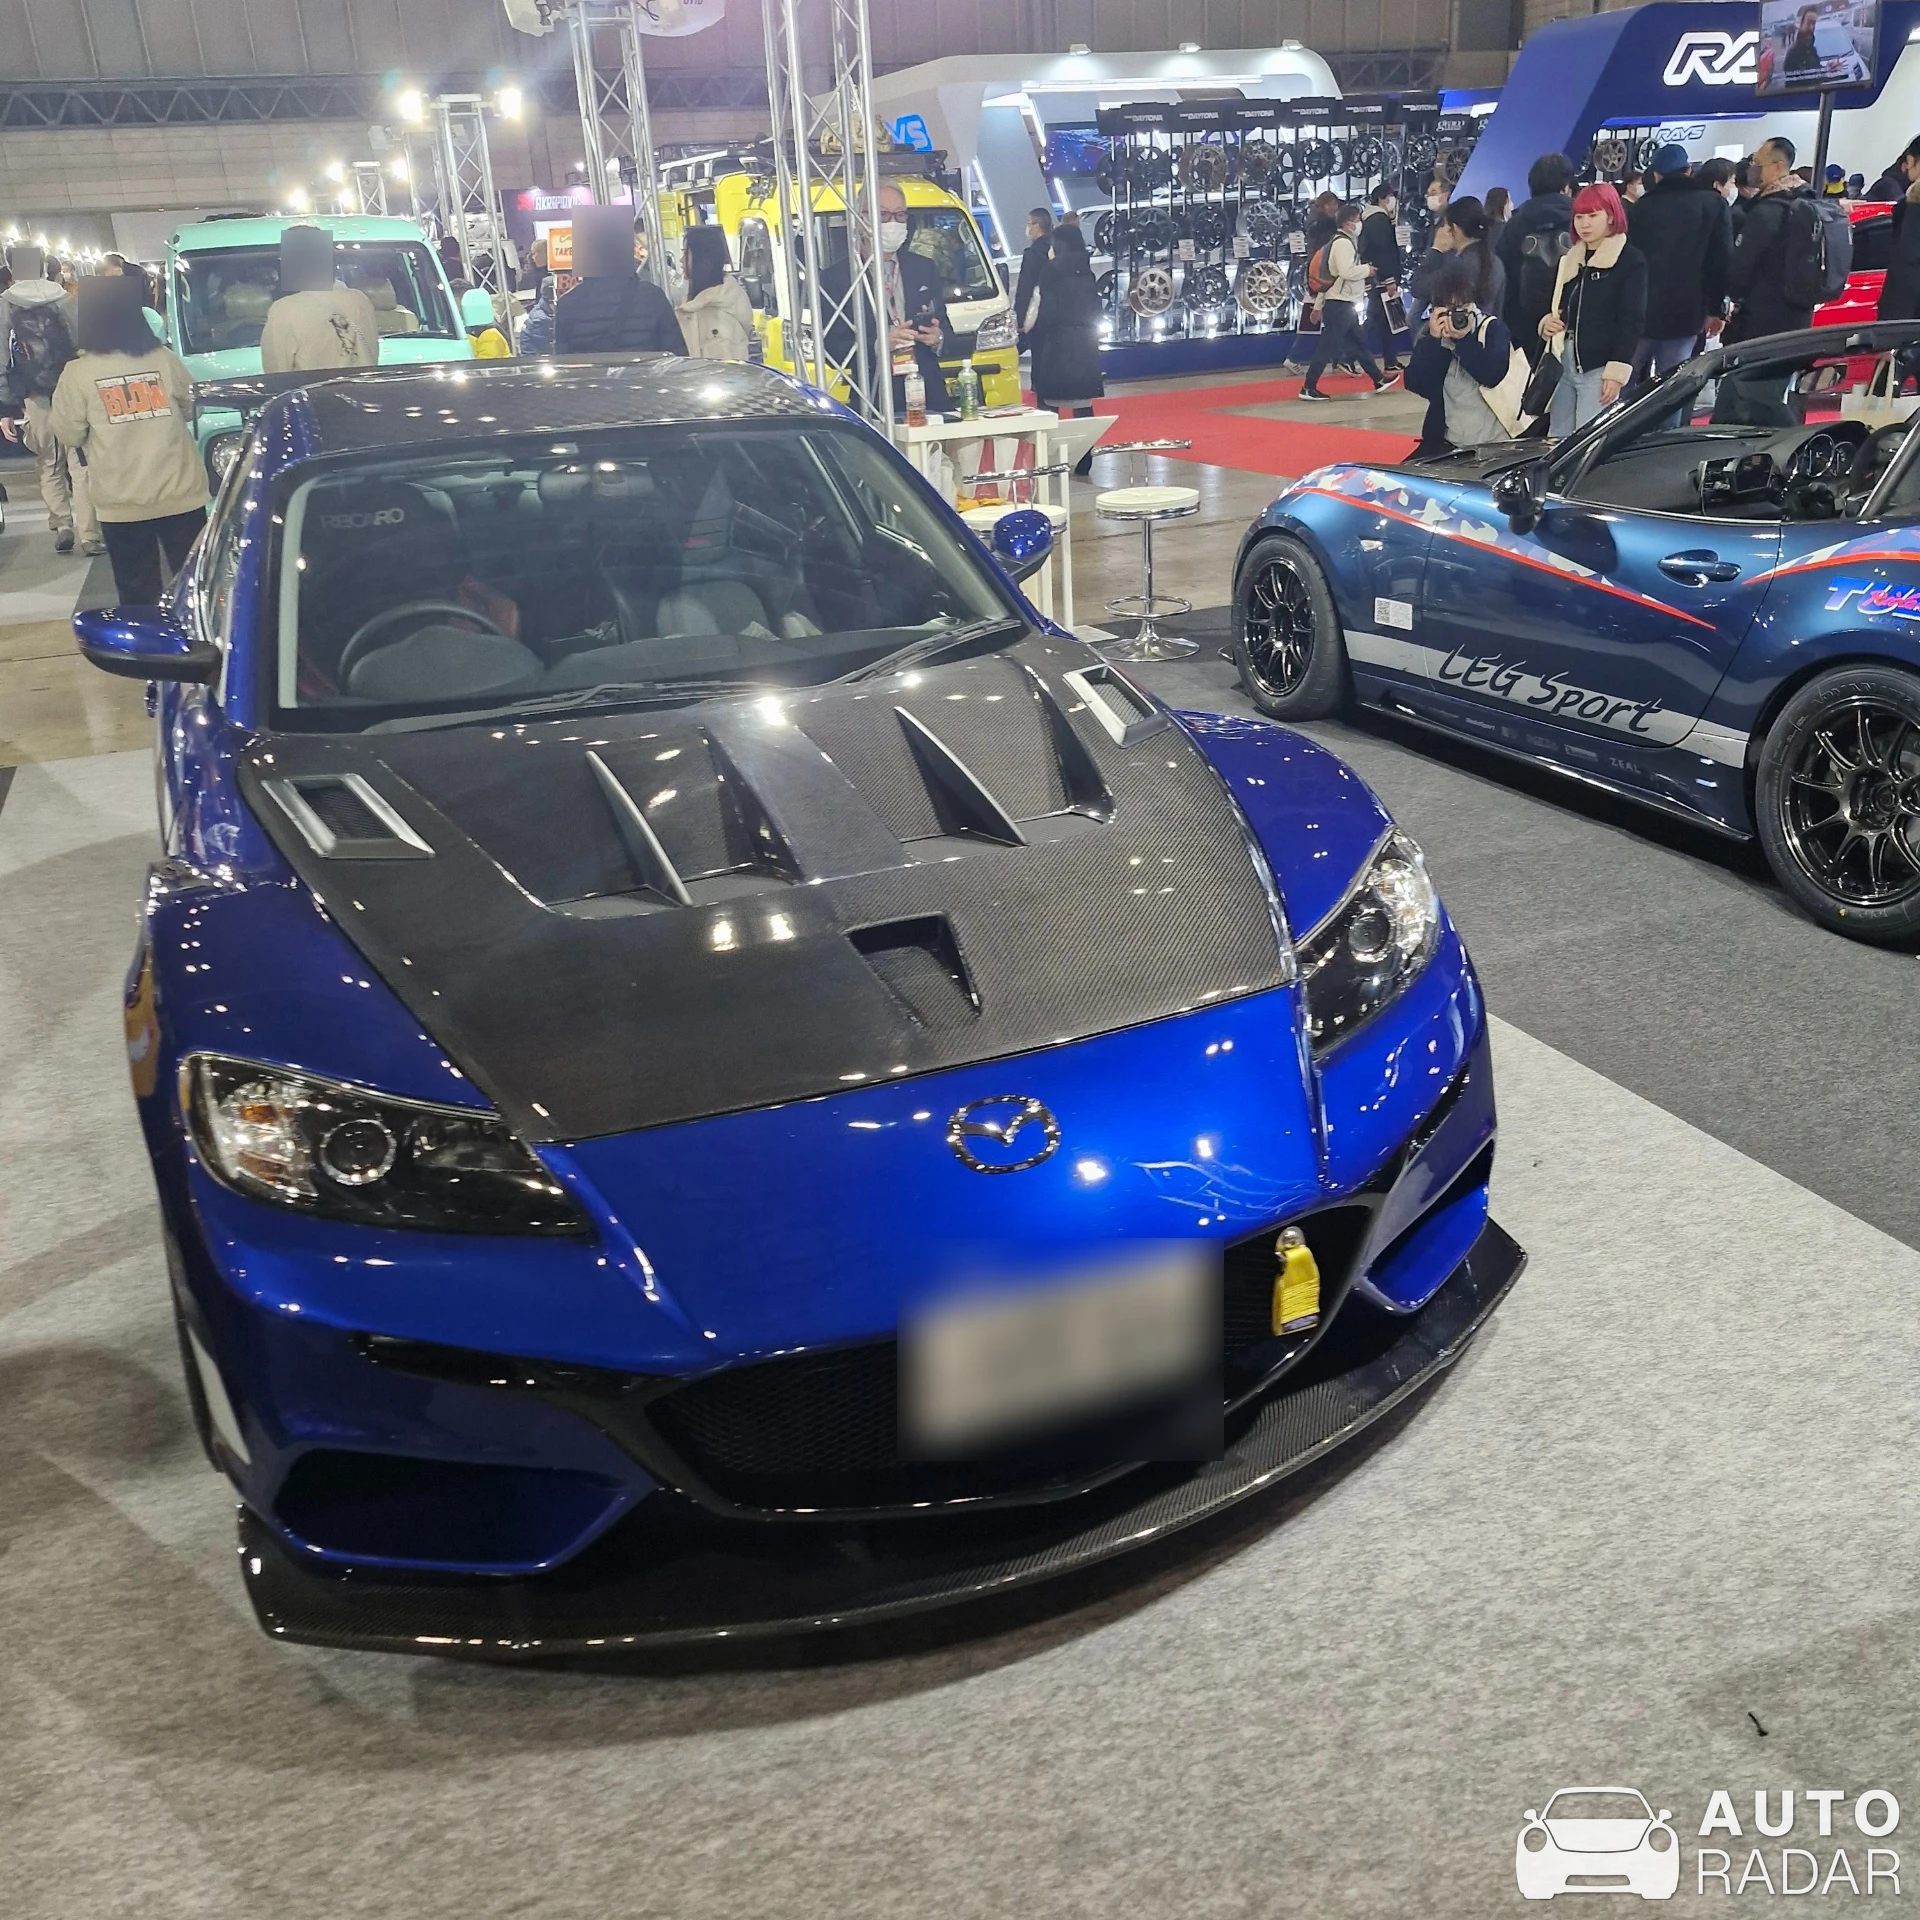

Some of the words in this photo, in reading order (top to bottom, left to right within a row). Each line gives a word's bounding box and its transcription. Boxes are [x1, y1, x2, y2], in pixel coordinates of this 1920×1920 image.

[1132, 114, 1164, 122] DAYTONA
[1188, 112, 1219, 120] DAYTONA
[1655, 125, 1706, 142] RAYS
[98, 380, 169, 418] BLOW
[321, 508, 404, 528] RECARO
[1439, 644, 1527, 697] LEG
[1526, 671, 1662, 733] Sport
[1609, 757, 1641, 773] ZEAL
